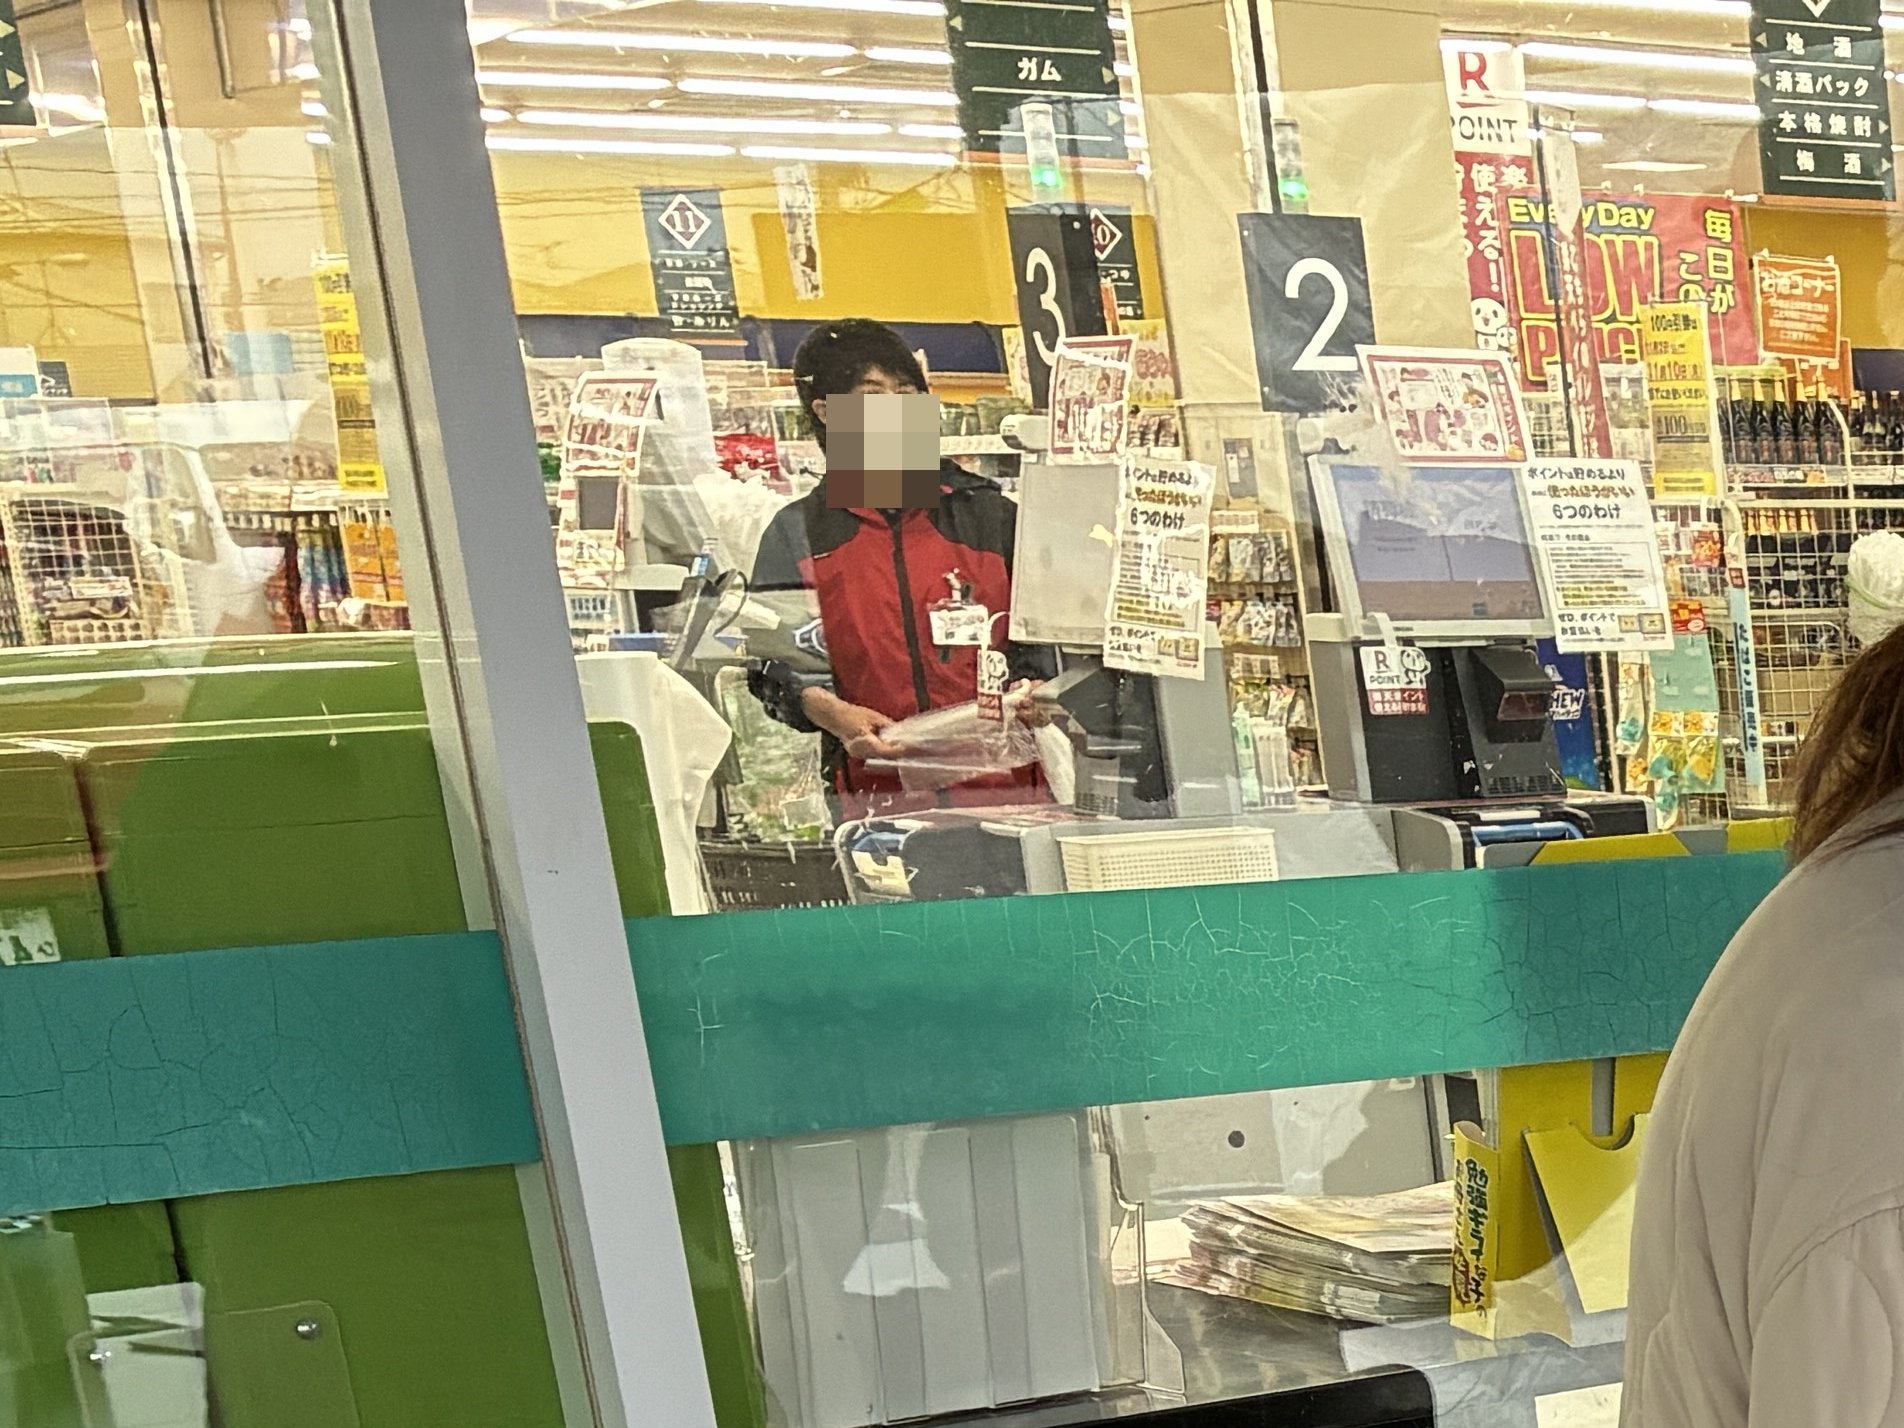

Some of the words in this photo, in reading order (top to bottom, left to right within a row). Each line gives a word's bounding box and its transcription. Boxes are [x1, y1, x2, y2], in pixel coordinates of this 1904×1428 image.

[1785, 31, 1852, 59] 地酒
[1017, 57, 1063, 82] ガム
[1458, 51, 1490, 91] R
[1775, 69, 1870, 97] 清酒パック
[1778, 111, 1873, 139] 本格焼酎
[1704, 209, 1736, 314] 毎日が
[1284, 256, 1360, 371] 2
[1552, 503, 1622, 520] 6つのわけ
[1373, 650, 1390, 671] R
[1369, 675, 1401, 685] POINT
